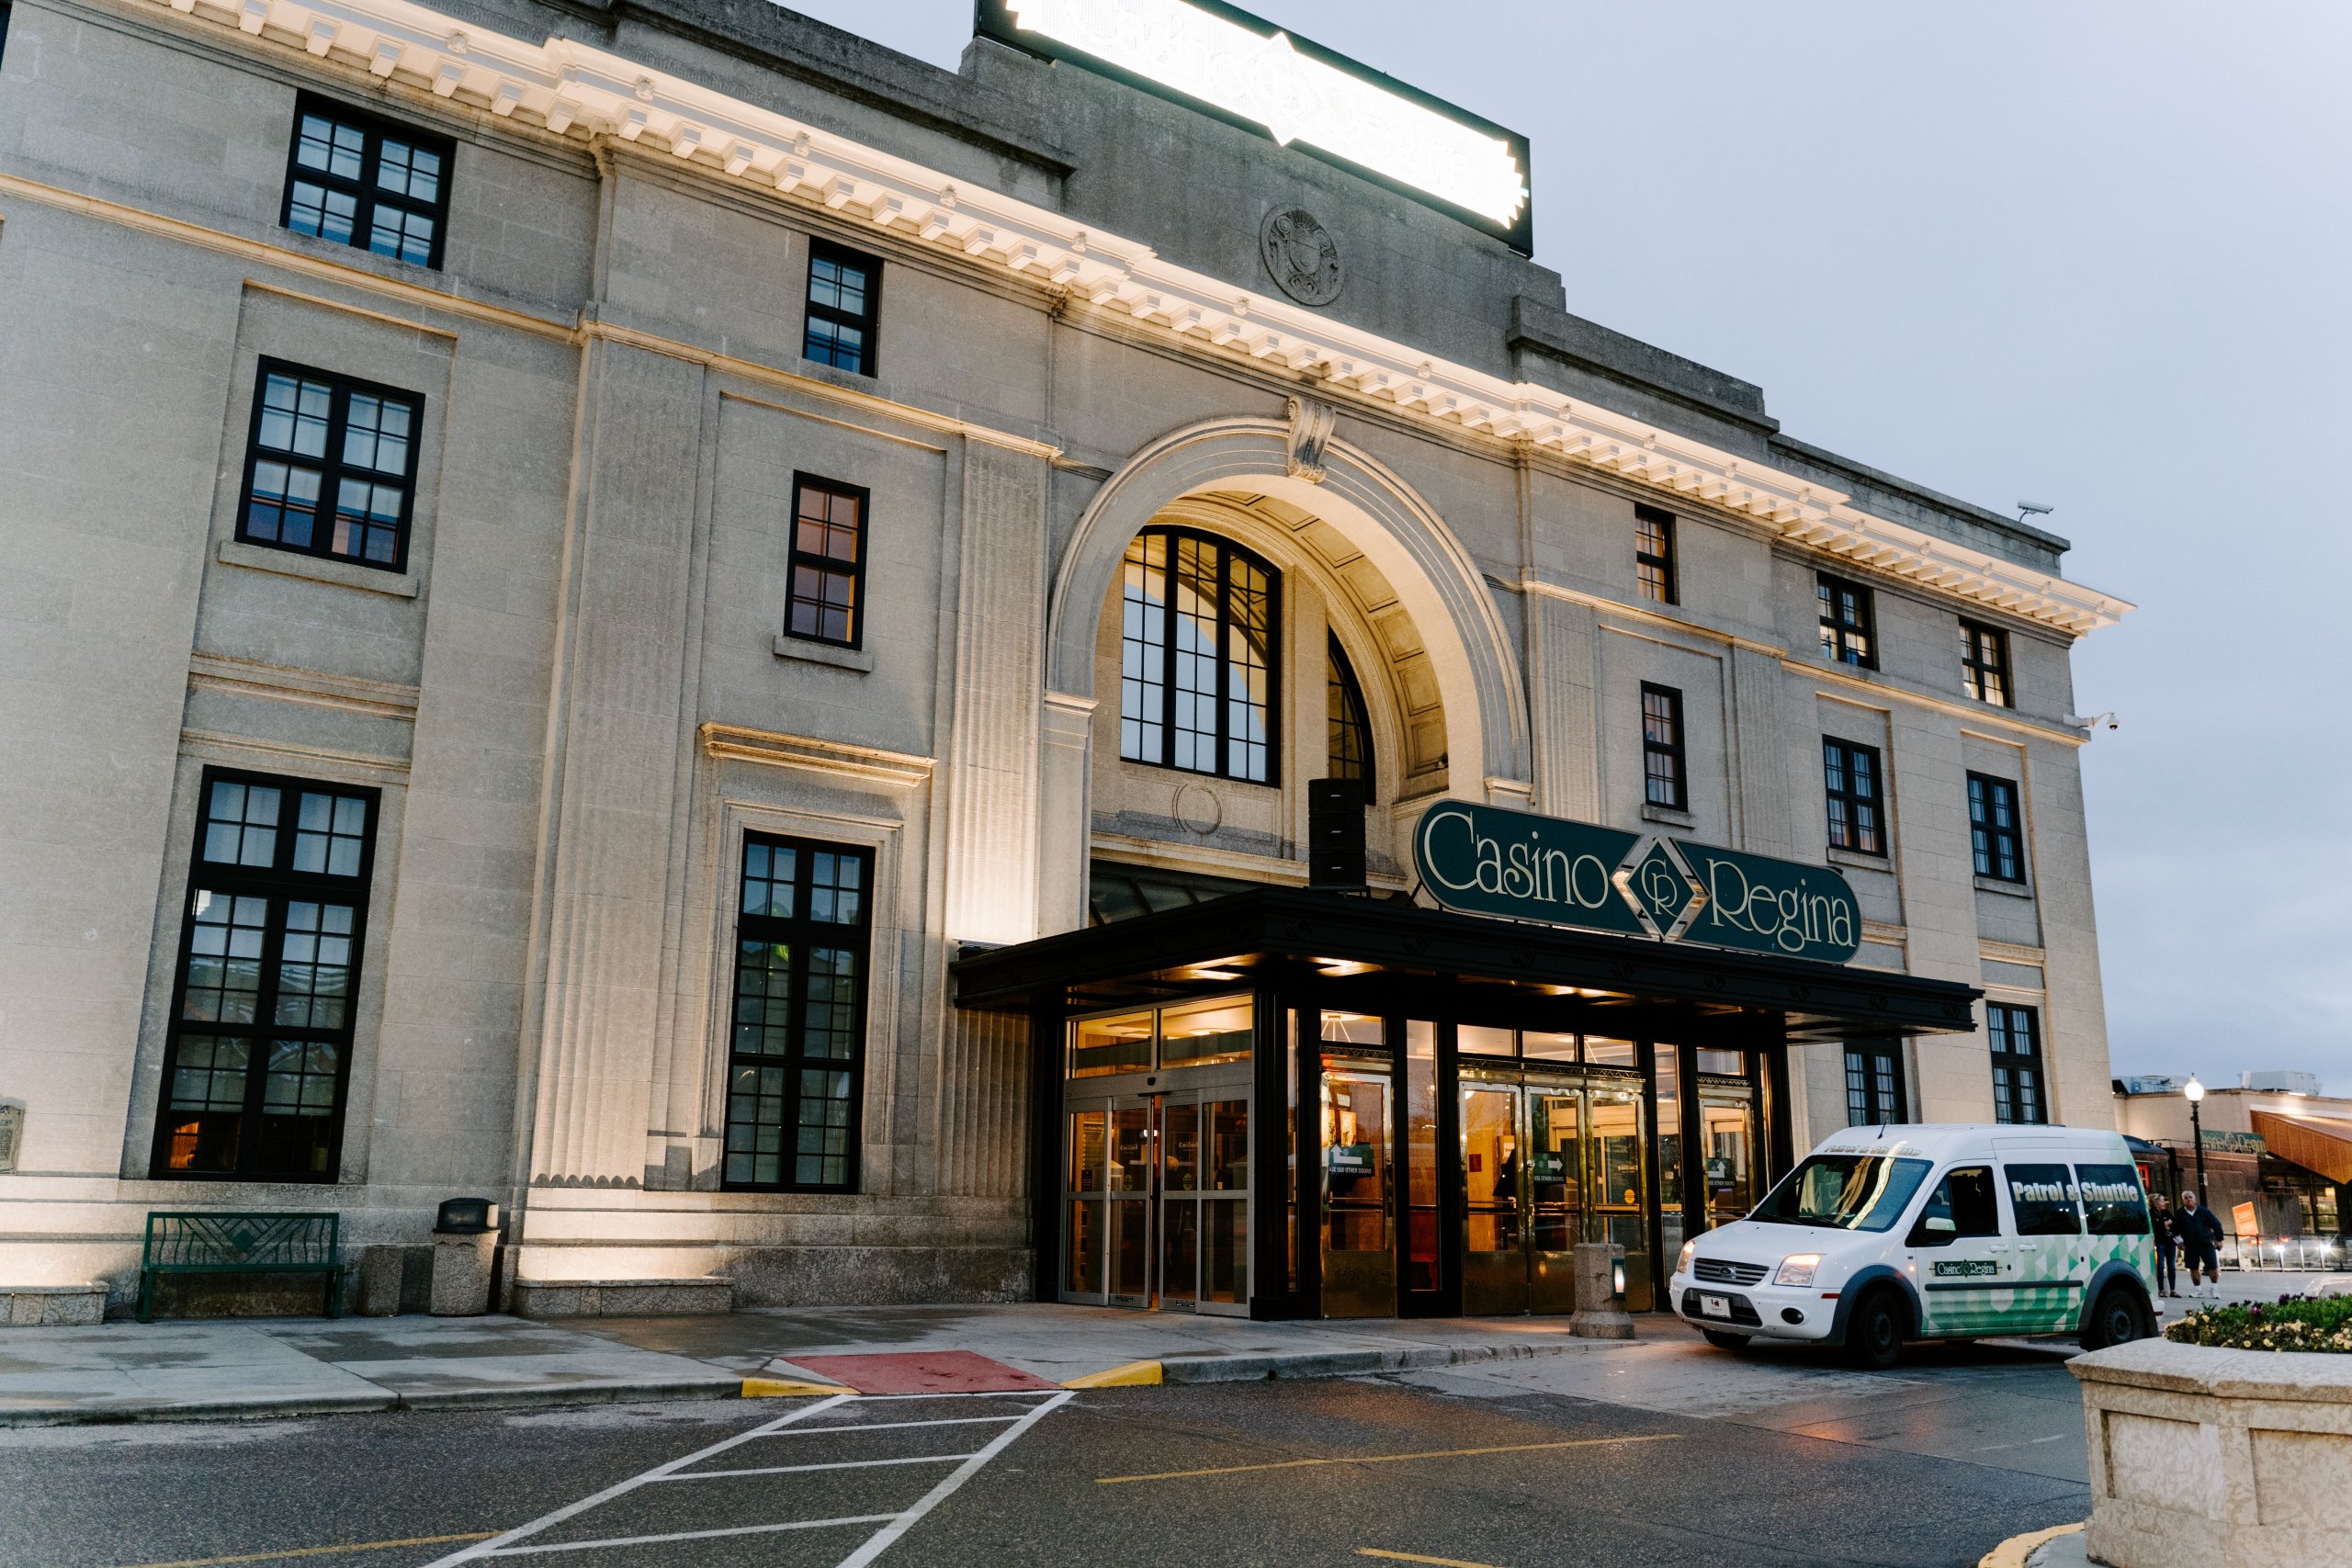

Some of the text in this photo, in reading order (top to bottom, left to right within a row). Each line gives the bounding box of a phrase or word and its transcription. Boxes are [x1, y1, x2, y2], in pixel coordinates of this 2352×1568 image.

[1424, 811, 1608, 909] Casino
[1706, 858, 1856, 953] Regina
[2011, 1181, 2140, 1202] Patrol & Shuttle
[1937, 1262, 1962, 1275] Casino
[1970, 1262, 1996, 1276] Regina
